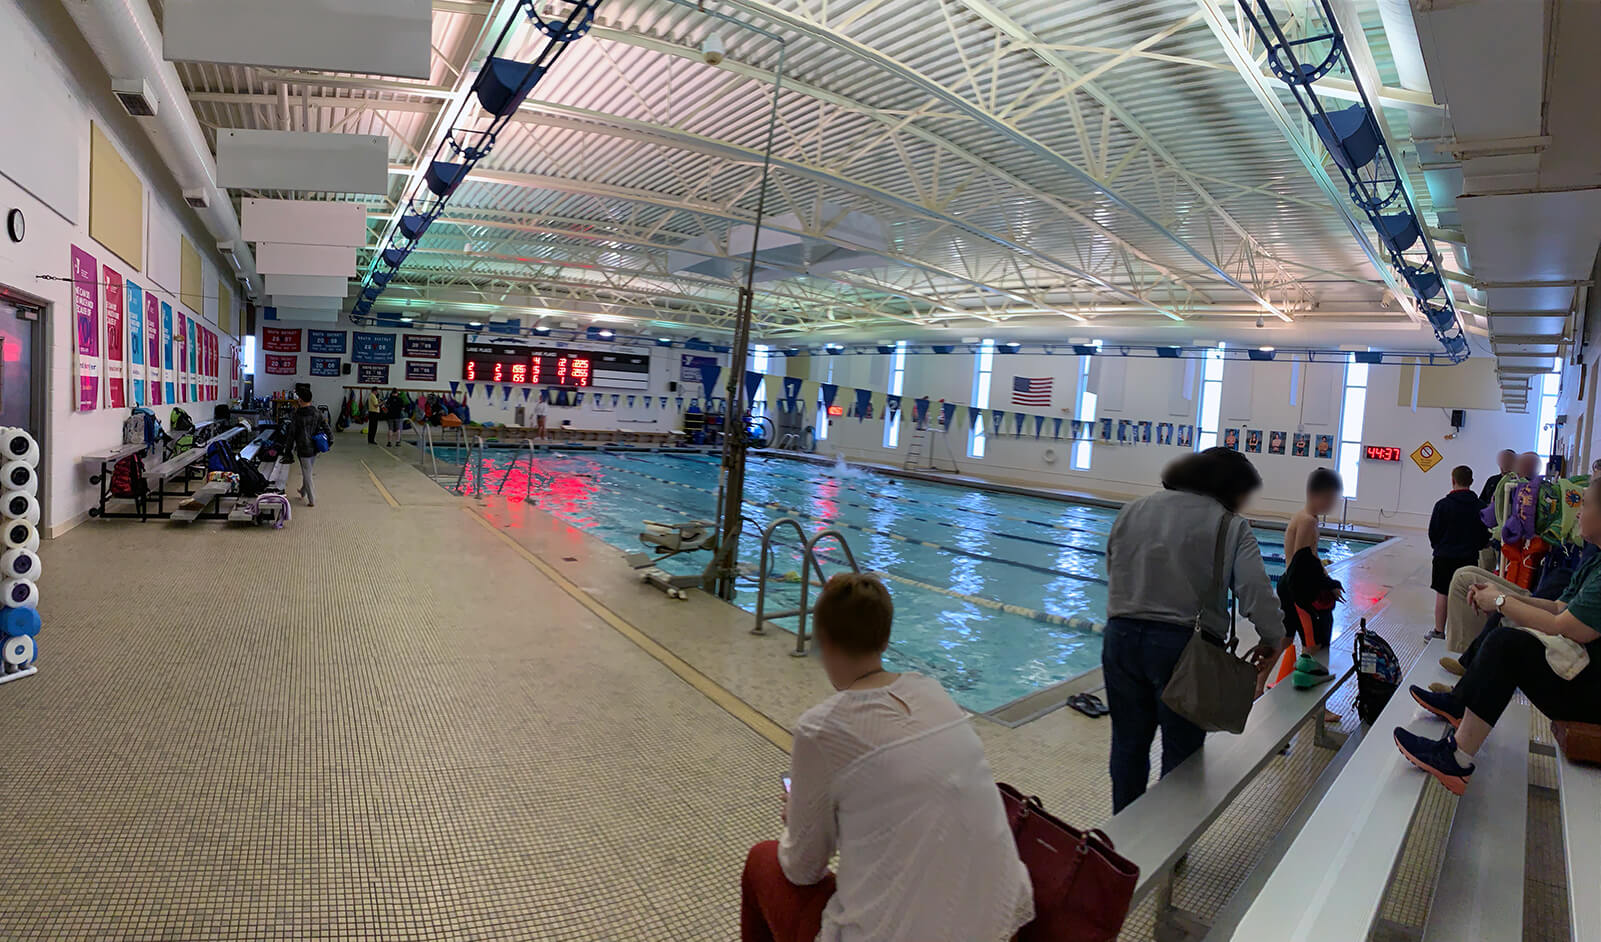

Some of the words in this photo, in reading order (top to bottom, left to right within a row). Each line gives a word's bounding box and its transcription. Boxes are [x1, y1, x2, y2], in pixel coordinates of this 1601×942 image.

[467, 361, 475, 371] 2
[495, 363, 502, 372] 2
[532, 365, 541, 374] 5
[467, 371, 475, 380] 3
[532, 375, 539, 384] 6
[787, 383, 795, 397] 1
[1368, 447, 1400, 461] 44:37
